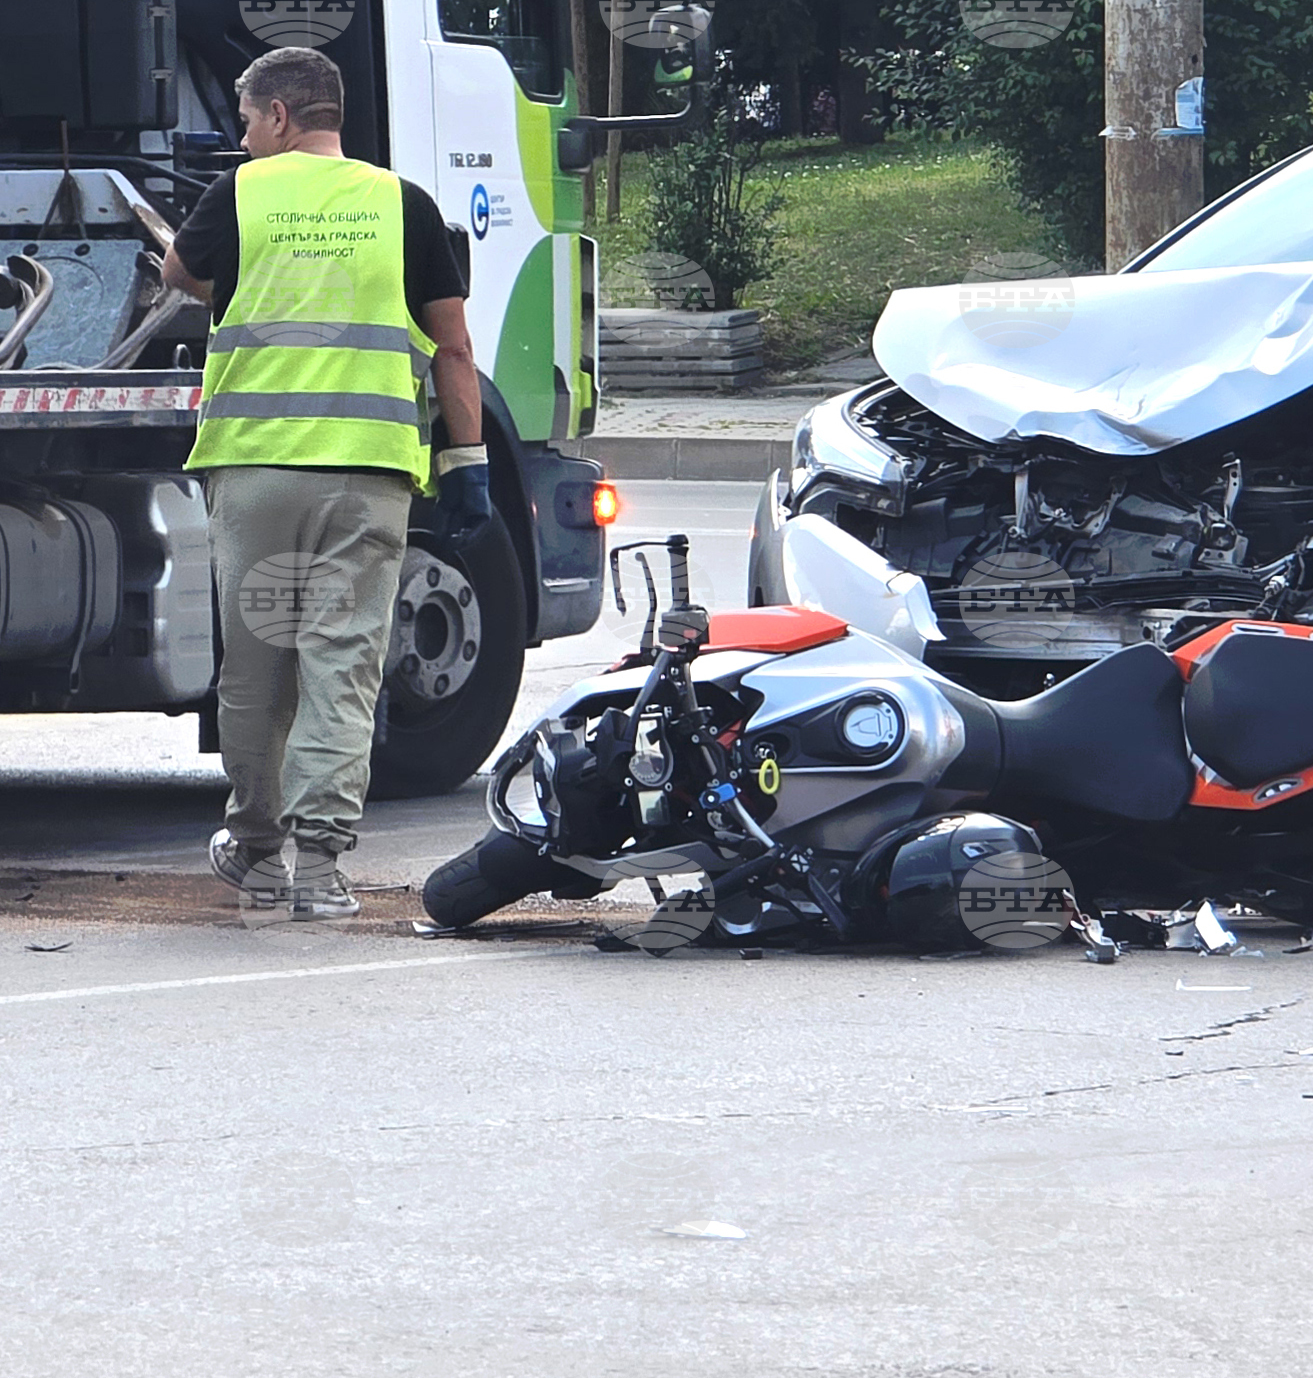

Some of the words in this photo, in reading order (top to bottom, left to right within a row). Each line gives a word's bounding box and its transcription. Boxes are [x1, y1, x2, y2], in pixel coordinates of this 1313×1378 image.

[266, 212, 326, 224] СТОЛИЧНА
[328, 210, 380, 224] ОБЩИНА
[270, 233, 311, 244] ЦЕНТЪР
[313, 233, 326, 242] ЗА
[329, 231, 377, 242] ГРАДСКА
[292, 248, 355, 259] МОБИЛНОСТ
